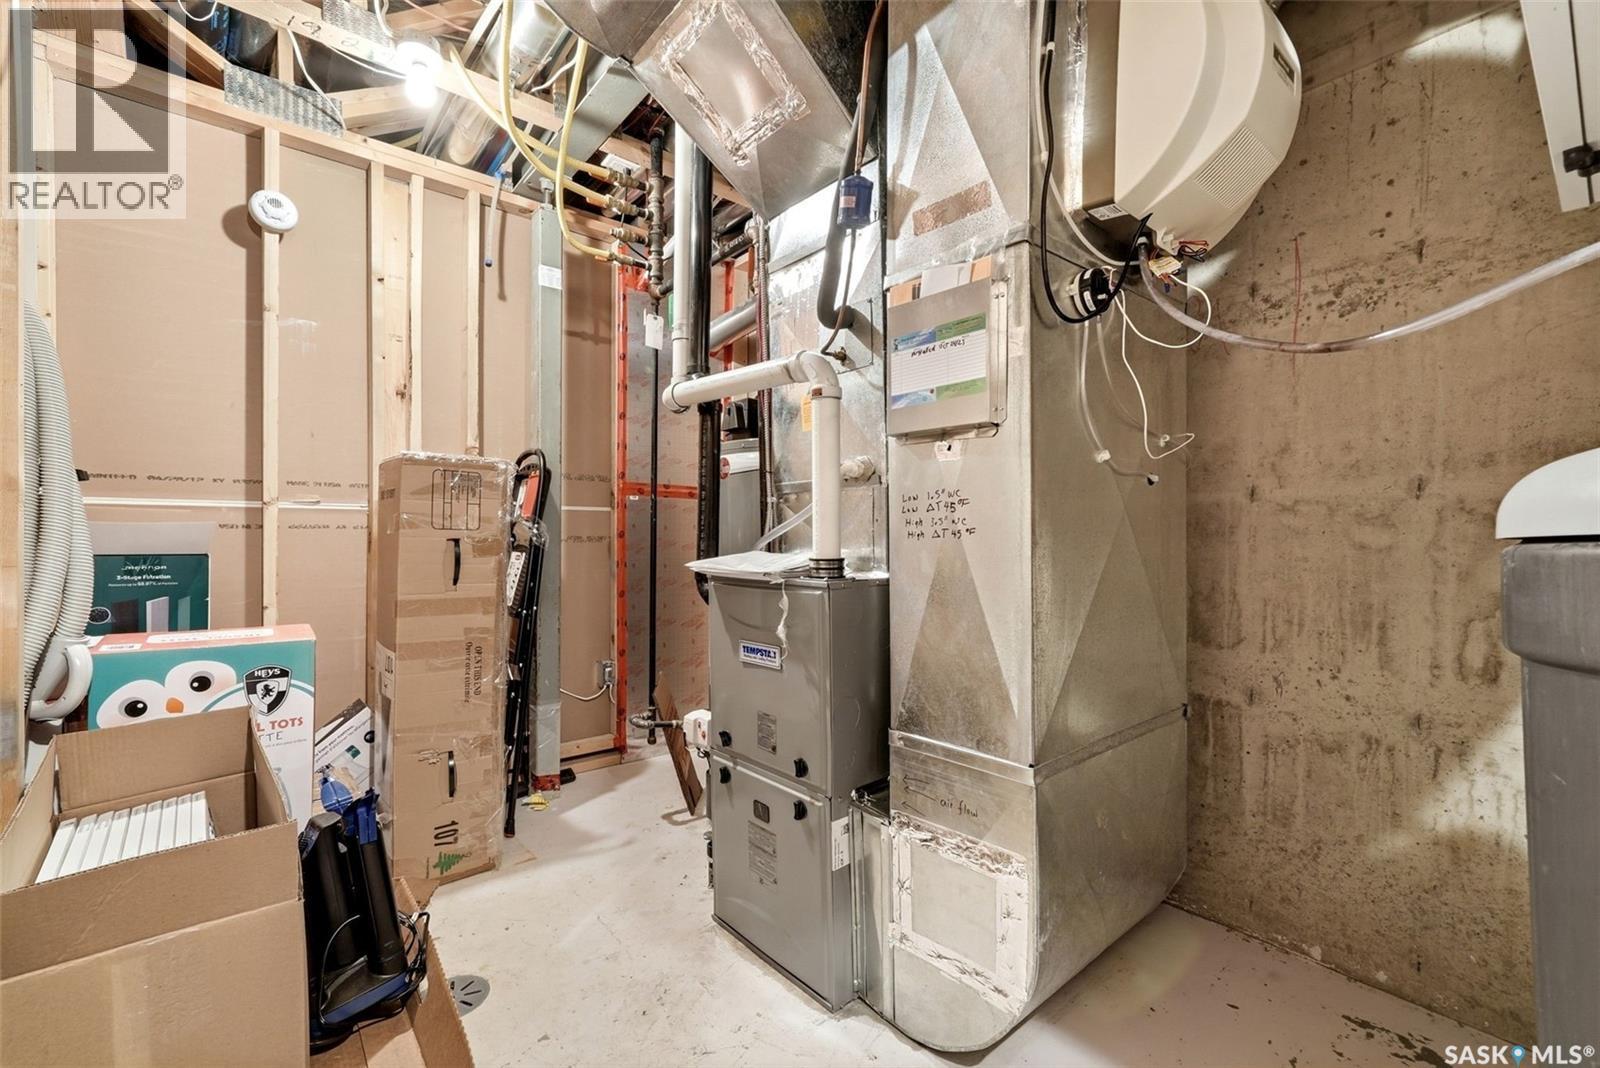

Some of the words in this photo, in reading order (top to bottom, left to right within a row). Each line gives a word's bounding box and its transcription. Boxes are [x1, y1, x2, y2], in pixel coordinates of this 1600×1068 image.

[474, 646, 482, 665] OPEN
[254, 668, 281, 678] HEYS
[473, 665, 482, 681] THIS
[474, 682, 482, 696] END
[269, 716, 304, 731] TOTS
[939, 799, 953, 808] air
[957, 799, 978, 818] flow
